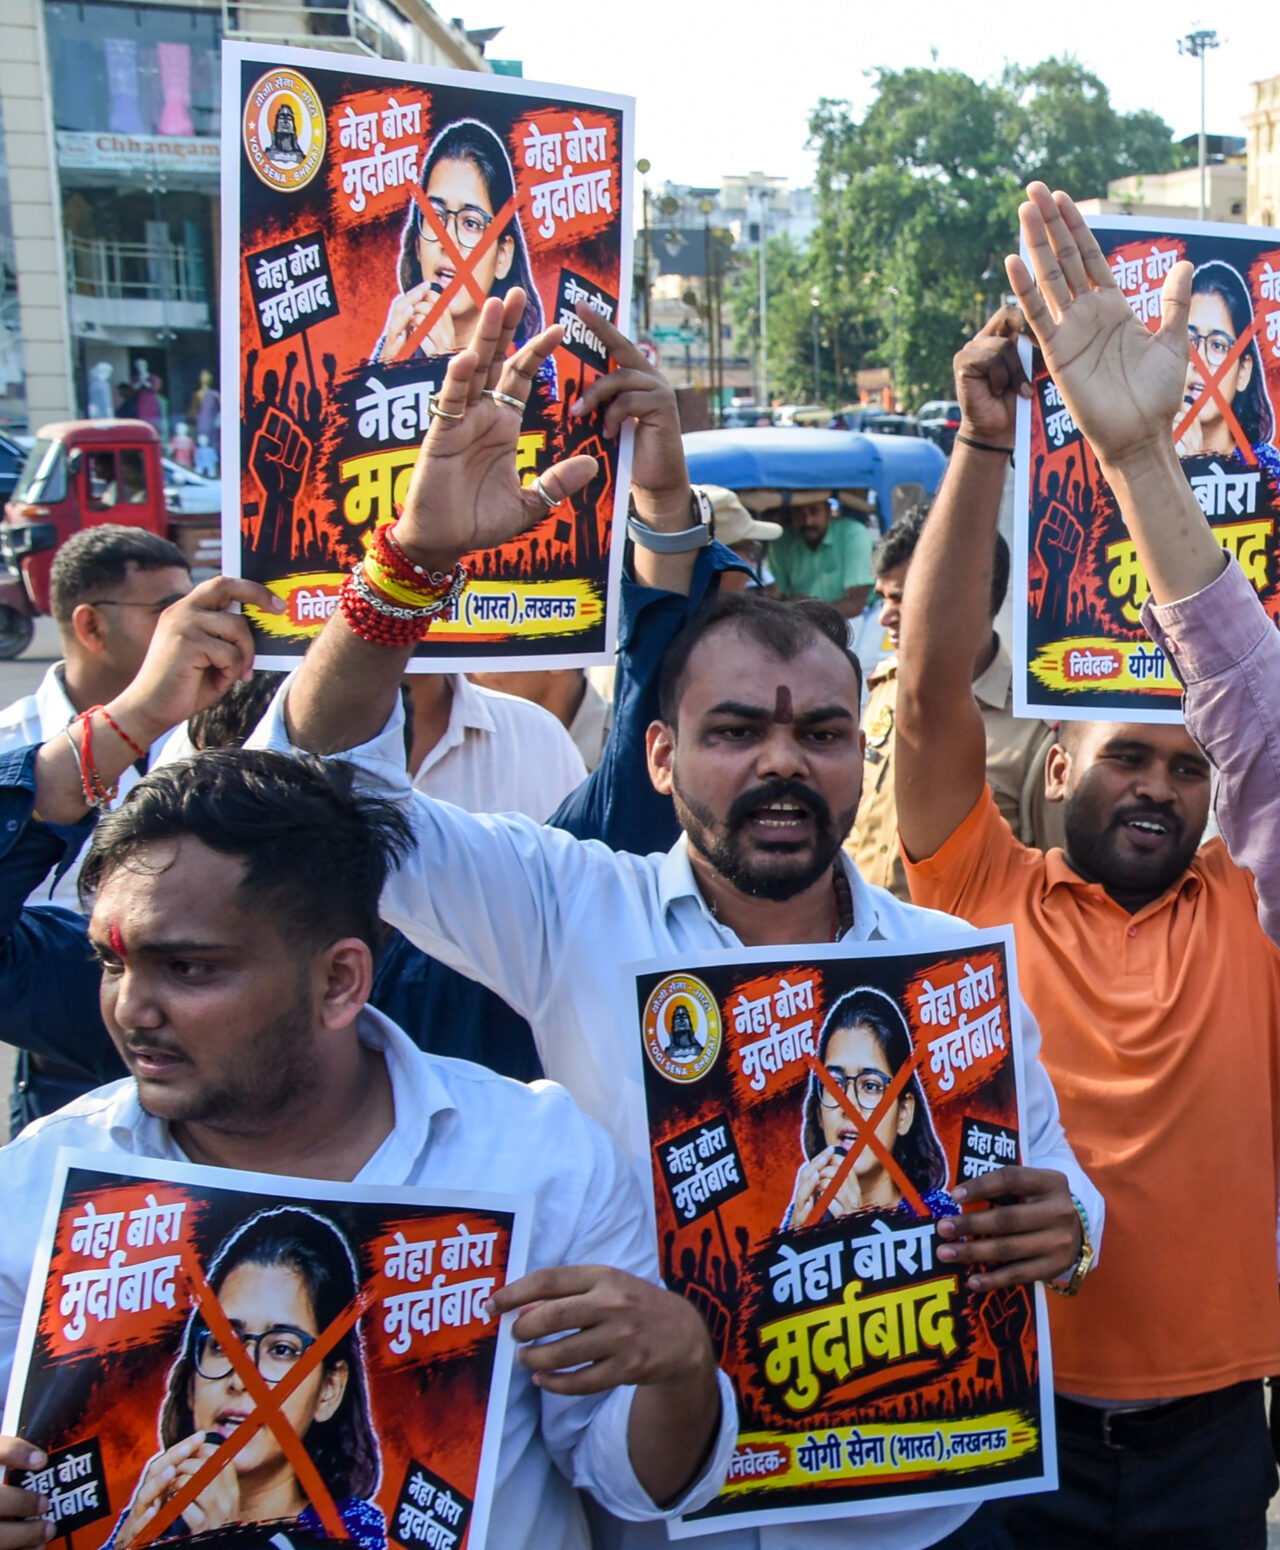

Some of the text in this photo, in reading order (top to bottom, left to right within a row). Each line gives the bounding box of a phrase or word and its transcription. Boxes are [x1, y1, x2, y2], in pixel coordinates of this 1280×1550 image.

[338, 97, 422, 151] नेहा बोरा
[523, 116, 607, 174] नेहा बोरा
[341, 142, 422, 212] मुर्दाबाद
[530, 165, 612, 239] मुर्दाबाद
[255, 244, 321, 289] नेहा बोरा
[258, 275, 331, 339] मुर्दाबाद
[356, 376, 434, 442] नेहा
[1190, 462, 1261, 516] बोरा
[1128, 646, 1166, 679] योगी
[733, 979, 814, 1034] नेहा बोरा
[918, 963, 996, 1026] नेहा बोरा
[739, 1019, 817, 1091] मुर्दाबाद
[927, 1005, 1005, 1091] मुर्दाबाद
[666, 1125, 727, 1174] नेहा बोरा
[967, 1124, 1016, 1160] नेहा बोरा
[672, 1152, 740, 1219] मुर्दाबाद
[71, 1194, 187, 1259] नेहा बोरा
[384, 1223, 498, 1283] नेहा बोरा
[769, 1218, 936, 1304] नेहा बोरा
[60, 1250, 182, 1342] मुर्दाबाद
[383, 1274, 496, 1355] मुर्दाबाद
[759, 1280, 958, 1410] मुर्दाबाद
[57, 1452, 93, 1483] बोरा
[797, 1436, 842, 1473] योगी
[847, 1430, 886, 1467] सेना
[398, 1502, 457, 1550] मुर्दाबाद
[407, 1472, 464, 1526] नेहा बोरा
